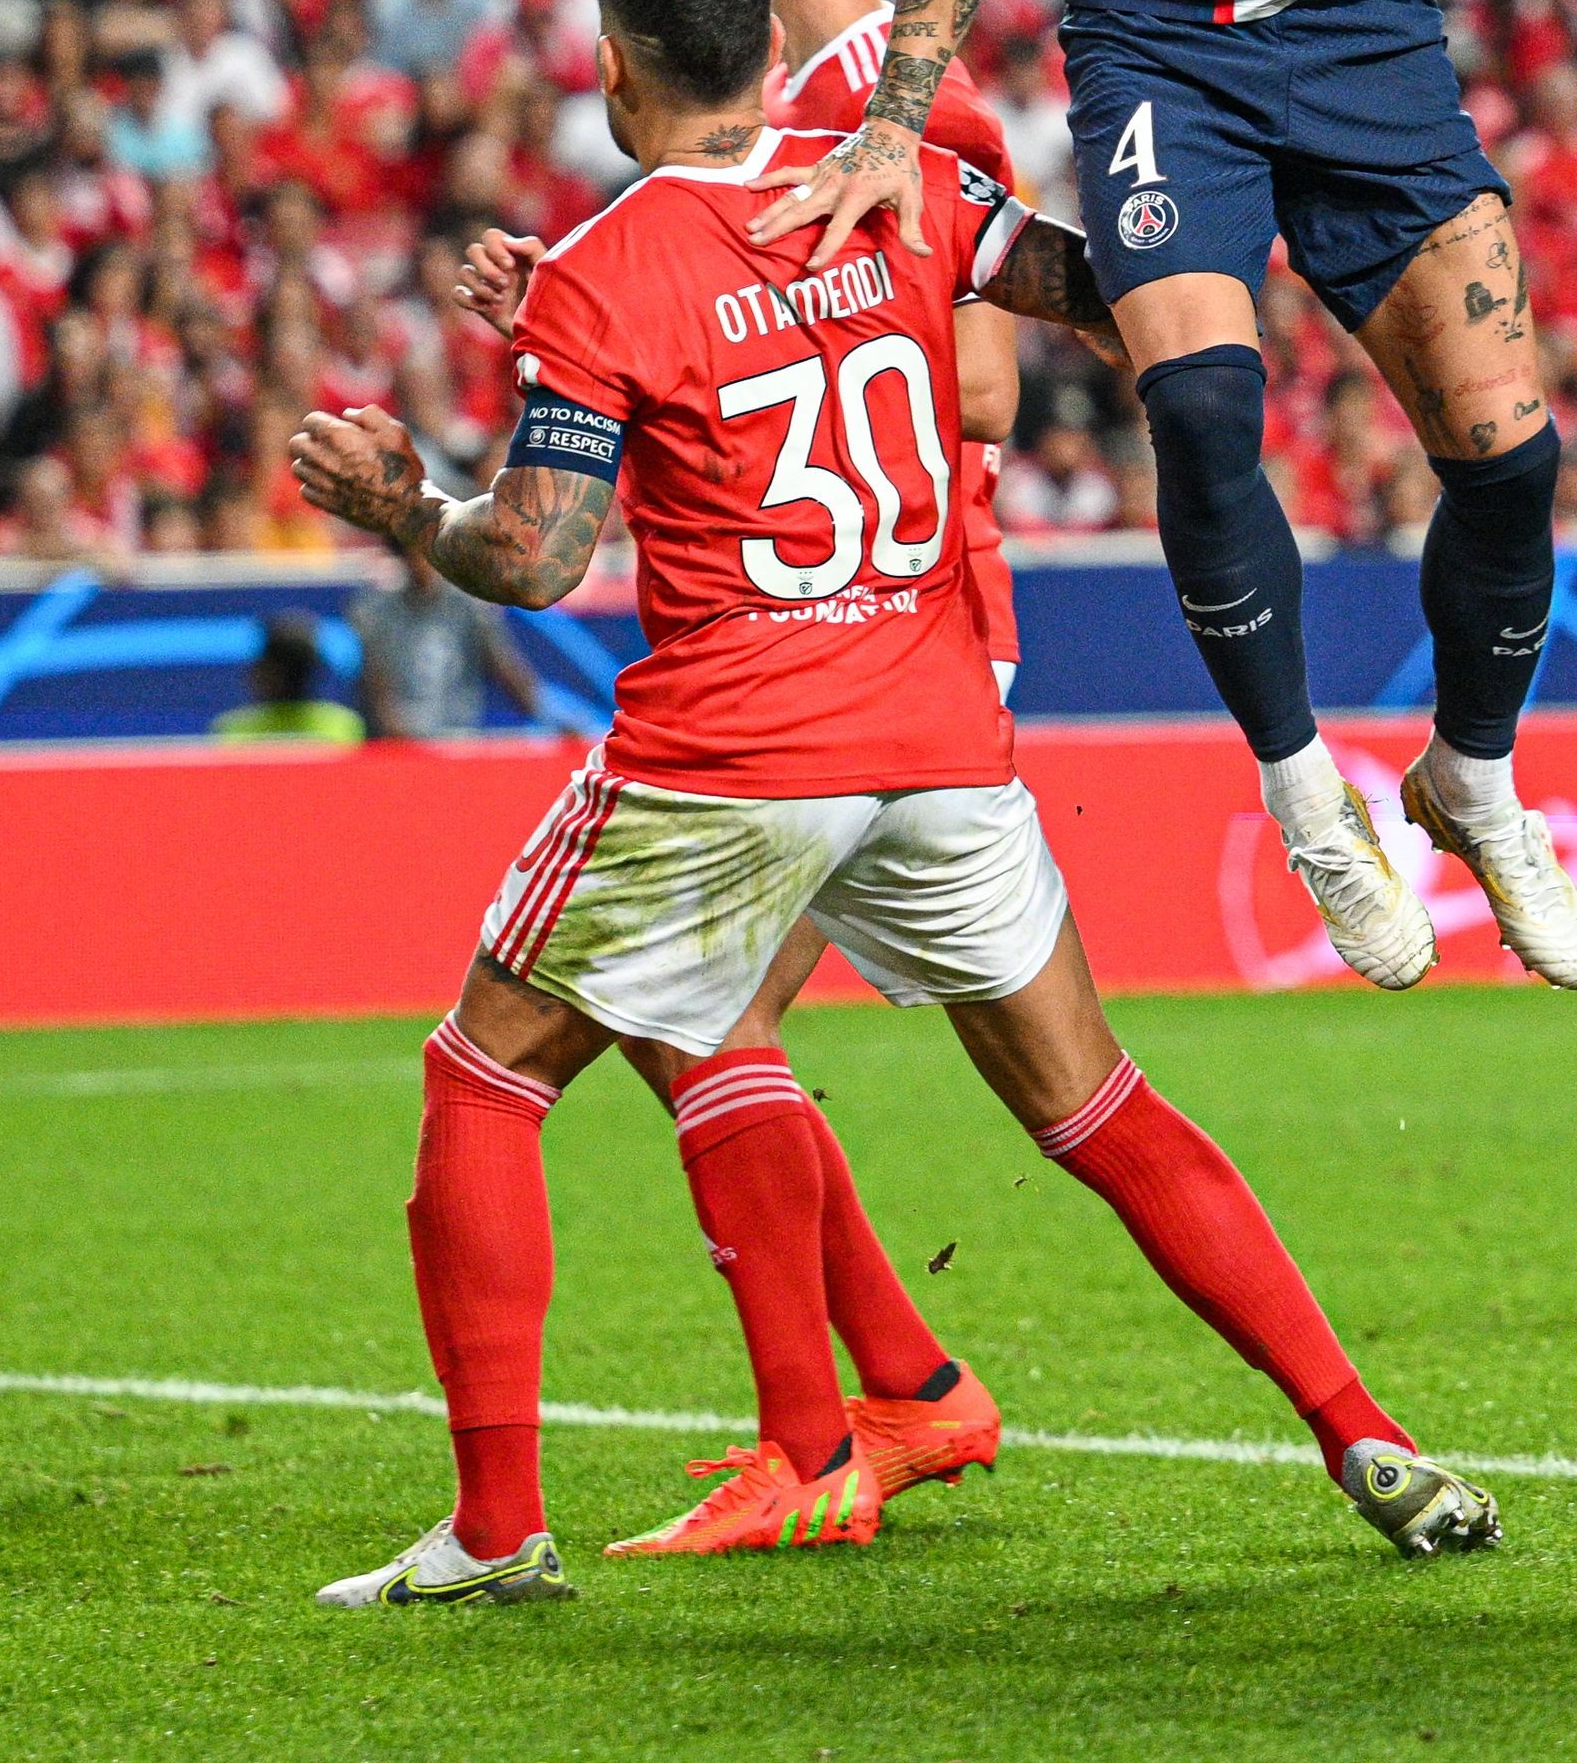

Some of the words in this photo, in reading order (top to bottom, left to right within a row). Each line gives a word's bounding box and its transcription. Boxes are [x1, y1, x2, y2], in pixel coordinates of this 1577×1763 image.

[1108, 101, 1167, 188] 4
[715, 249, 895, 344] OTAMENDI
[528, 407, 548, 419] NO
[550, 408, 571, 421] TO
[573, 411, 621, 436] RACISM
[549, 431, 615, 458] RESPECT
[717, 333, 951, 600] 30
[1186, 608, 1273, 638] PARIS
[1492, 633, 1548, 656] PAR
